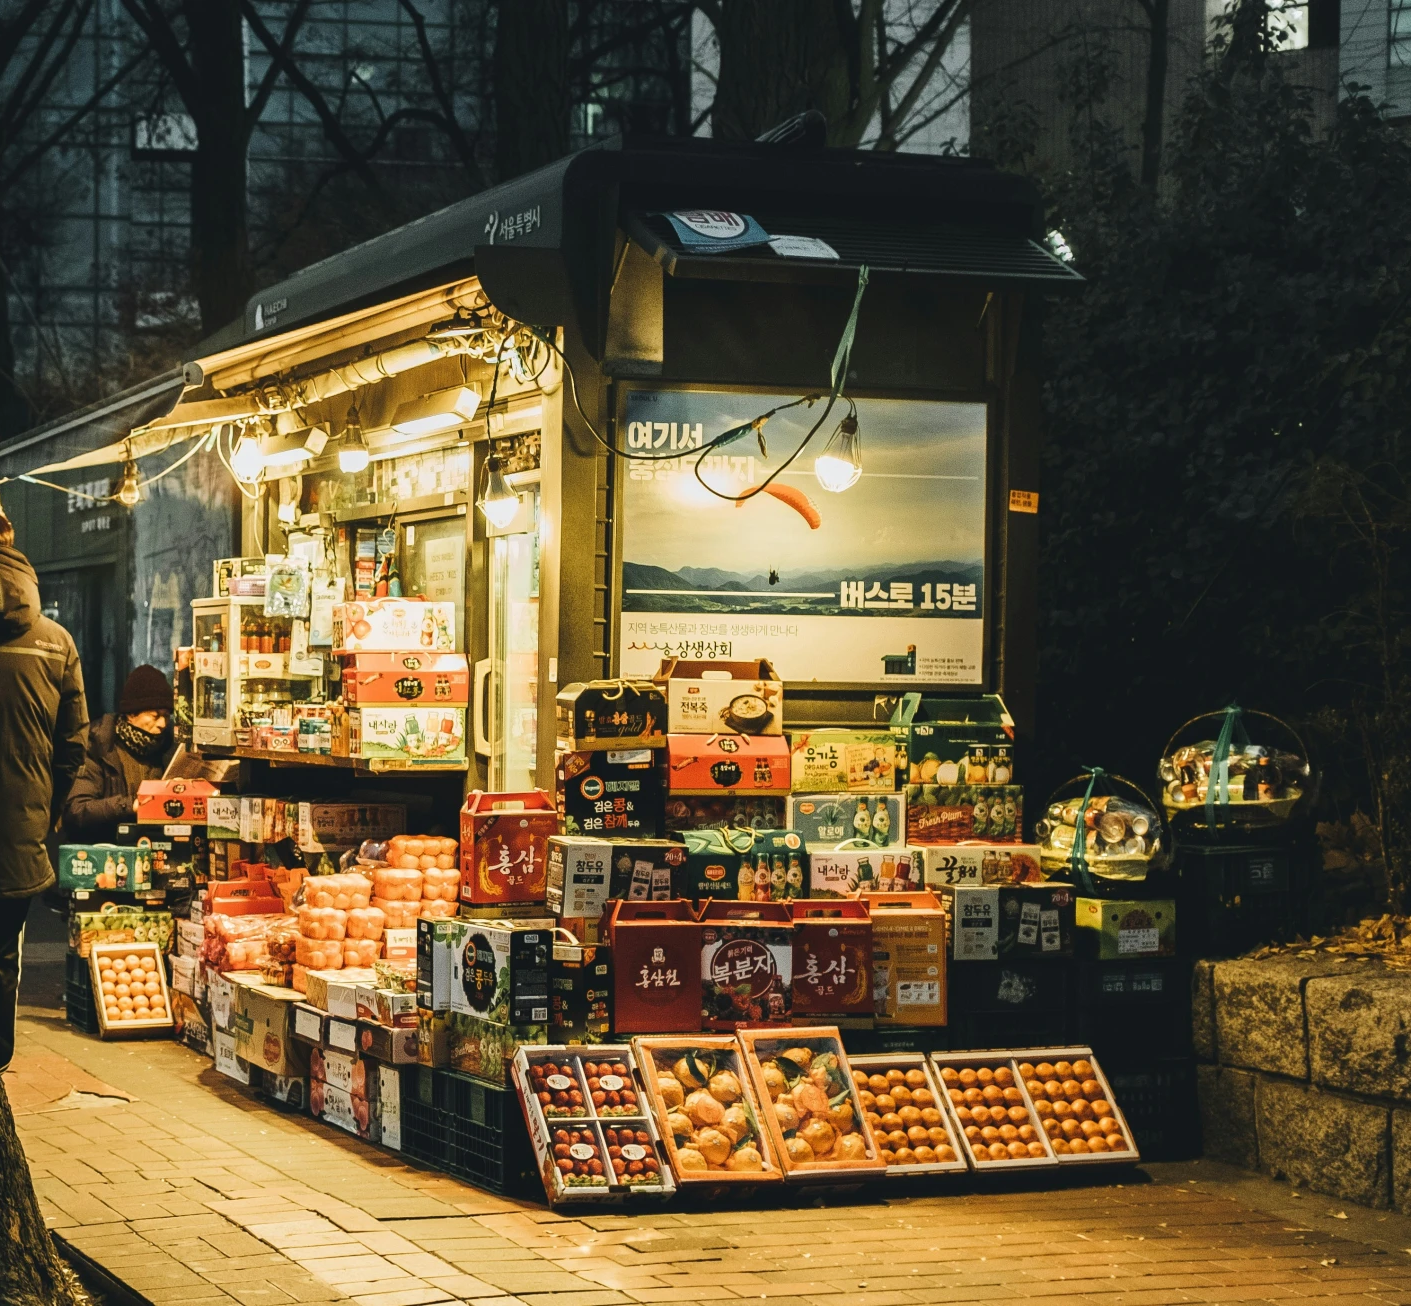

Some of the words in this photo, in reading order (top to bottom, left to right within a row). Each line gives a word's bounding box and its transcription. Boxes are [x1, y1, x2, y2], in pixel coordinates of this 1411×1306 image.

[499, 205, 540, 241] 서울특별시
[628, 421, 703, 450] 여기서
[840, 581, 914, 609] 버스로
[920, 583, 976, 611] 15분
[628, 622, 647, 634] 지역
[650, 622, 697, 635] 농특산물과
[700, 624, 728, 636] 정보를
[730, 624, 768, 637] 생생하게
[770, 625, 798, 637] 만나다
[676, 641, 732, 659] 상생상회
[680, 701, 708, 713] 전복죽
[804, 745, 838, 768] 유기농
[919, 816, 941, 829] Fresh
[941, 810, 963, 823] Plum
[818, 825, 844, 836] 알로에
[488, 844, 542, 874] 홍삼
[576, 860, 604, 873] 참두유
[818, 864, 850, 880] 내사랑
[964, 904, 991, 917] 참두유
[635, 965, 681, 988] 홍삼원
[712, 951, 774, 984] 복분자
[793, 953, 856, 985] 홍삼
